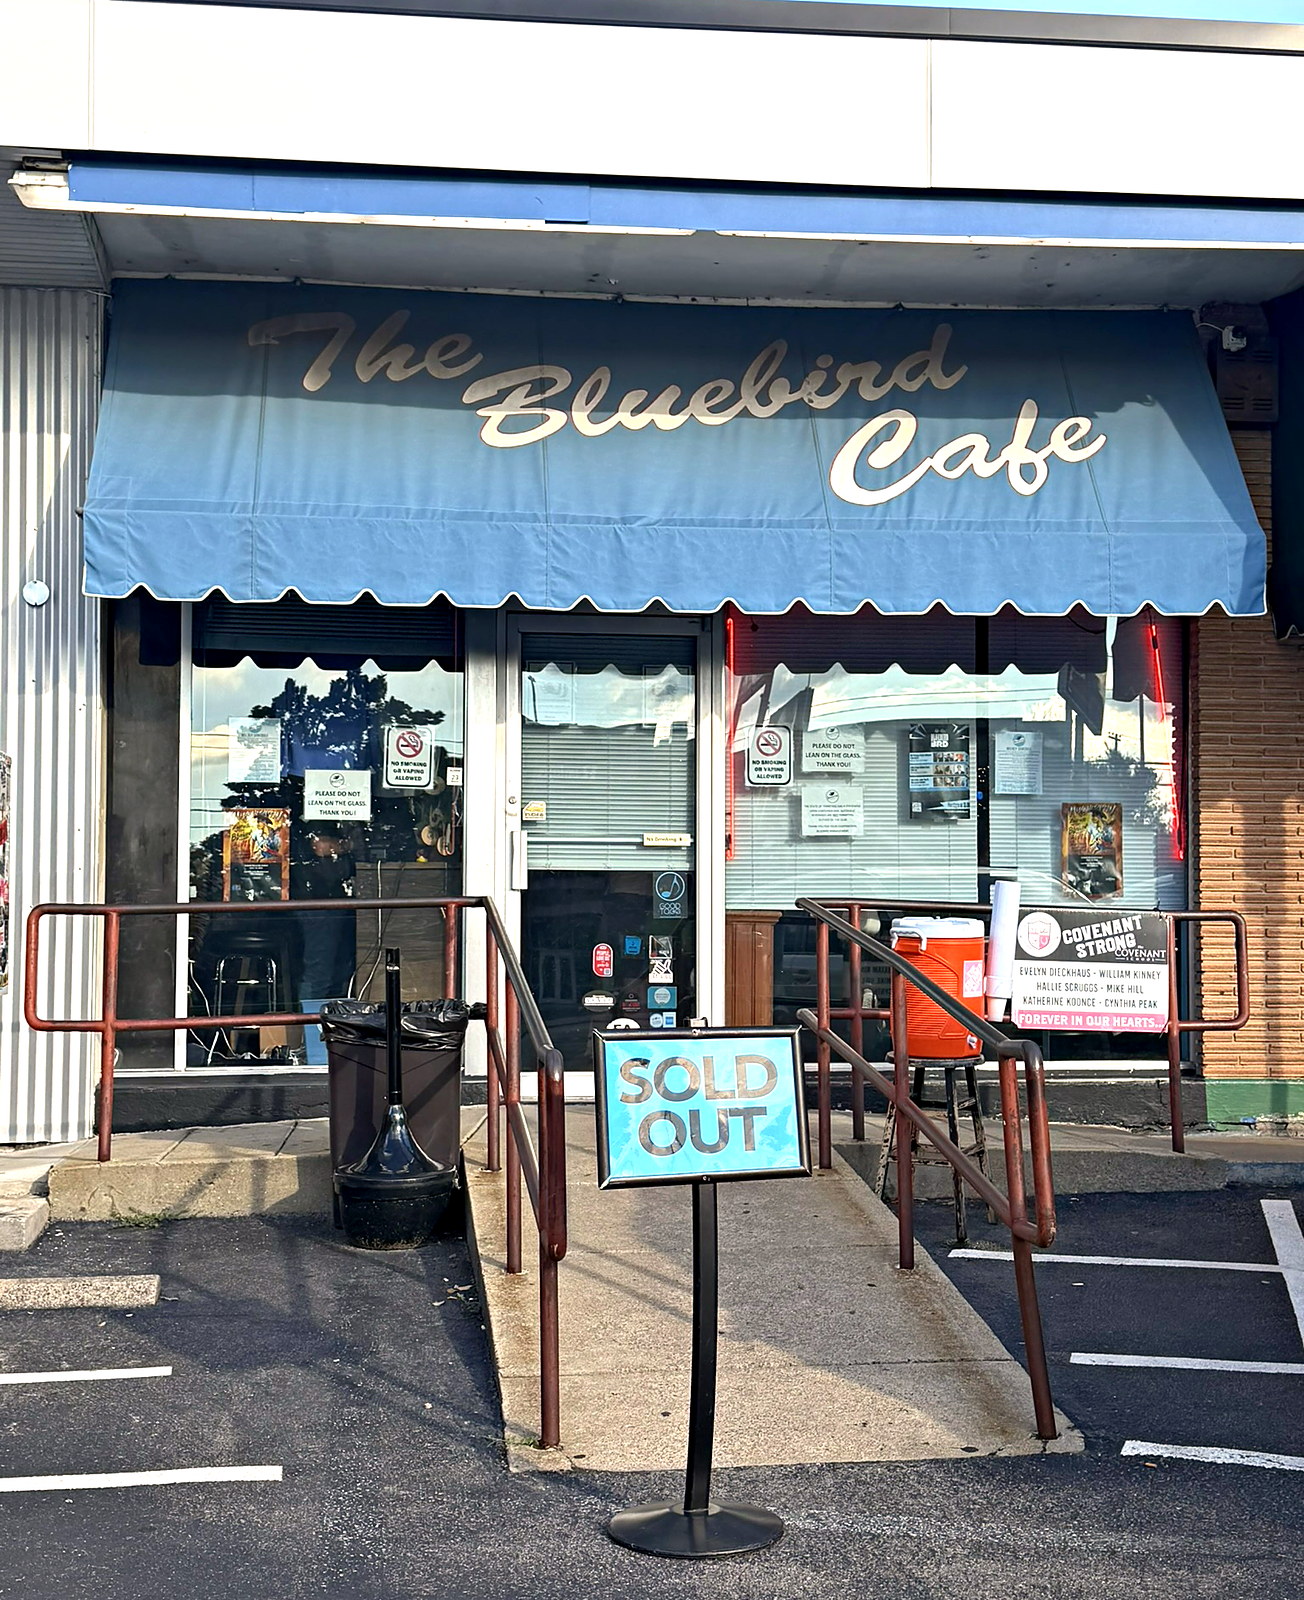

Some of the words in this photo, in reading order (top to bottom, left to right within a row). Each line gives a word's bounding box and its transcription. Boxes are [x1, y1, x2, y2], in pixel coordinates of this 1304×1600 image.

[247, 309, 484, 392] The
[461, 323, 969, 449] Bluebird
[829, 398, 1107, 507] Cafe
[1062, 915, 1142, 945] COVENANT
[1076, 933, 1136, 959] STRONG
[1115, 949, 1166, 958] COVENANT
[1019, 966, 1047, 976] EVELYN
[1049, 967, 1091, 978] DIECKHAUS
[1099, 969, 1131, 979] WILLIAM
[1133, 970, 1161, 980] KINNEY
[1036, 982, 1062, 991] HALLIE
[1064, 983, 1098, 993] SCRUGGS
[1106, 984, 1124, 993] MIKE
[1127, 985, 1144, 994] HILL
[1023, 996, 1063, 1006] KATHERINE
[1066, 997, 1096, 1007] KOONCE
[1104, 998, 1136, 1008] CYNTHIA
[1139, 1000, 1158, 1009] PEAK
[1019, 1013, 1068, 1025] FOREVER
[1071, 1015, 1083, 1026] IN
[1086, 1016, 1110, 1027] OUR
[619, 1054, 778, 1104] SOLD
[638, 1106, 767, 1156] OUT
